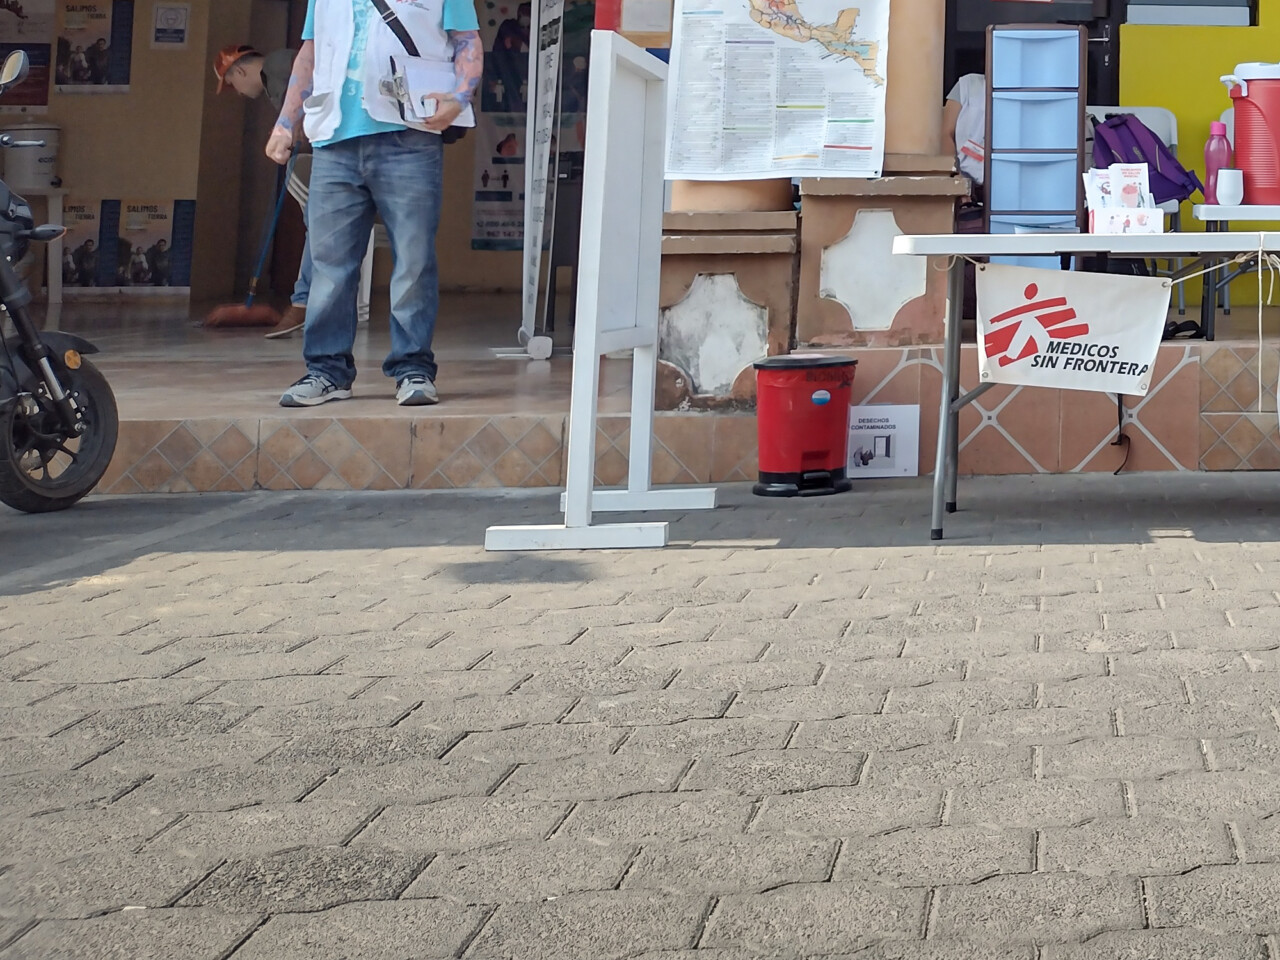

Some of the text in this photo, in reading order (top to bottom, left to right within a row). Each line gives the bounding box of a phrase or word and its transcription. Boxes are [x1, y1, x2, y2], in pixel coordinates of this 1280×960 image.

[63, 205, 86, 213] LIMOS
[126, 205, 158, 213] SALIMOS
[1046, 340, 1119, 358] MEDICOS
[1031, 355, 1059, 368] SIN
